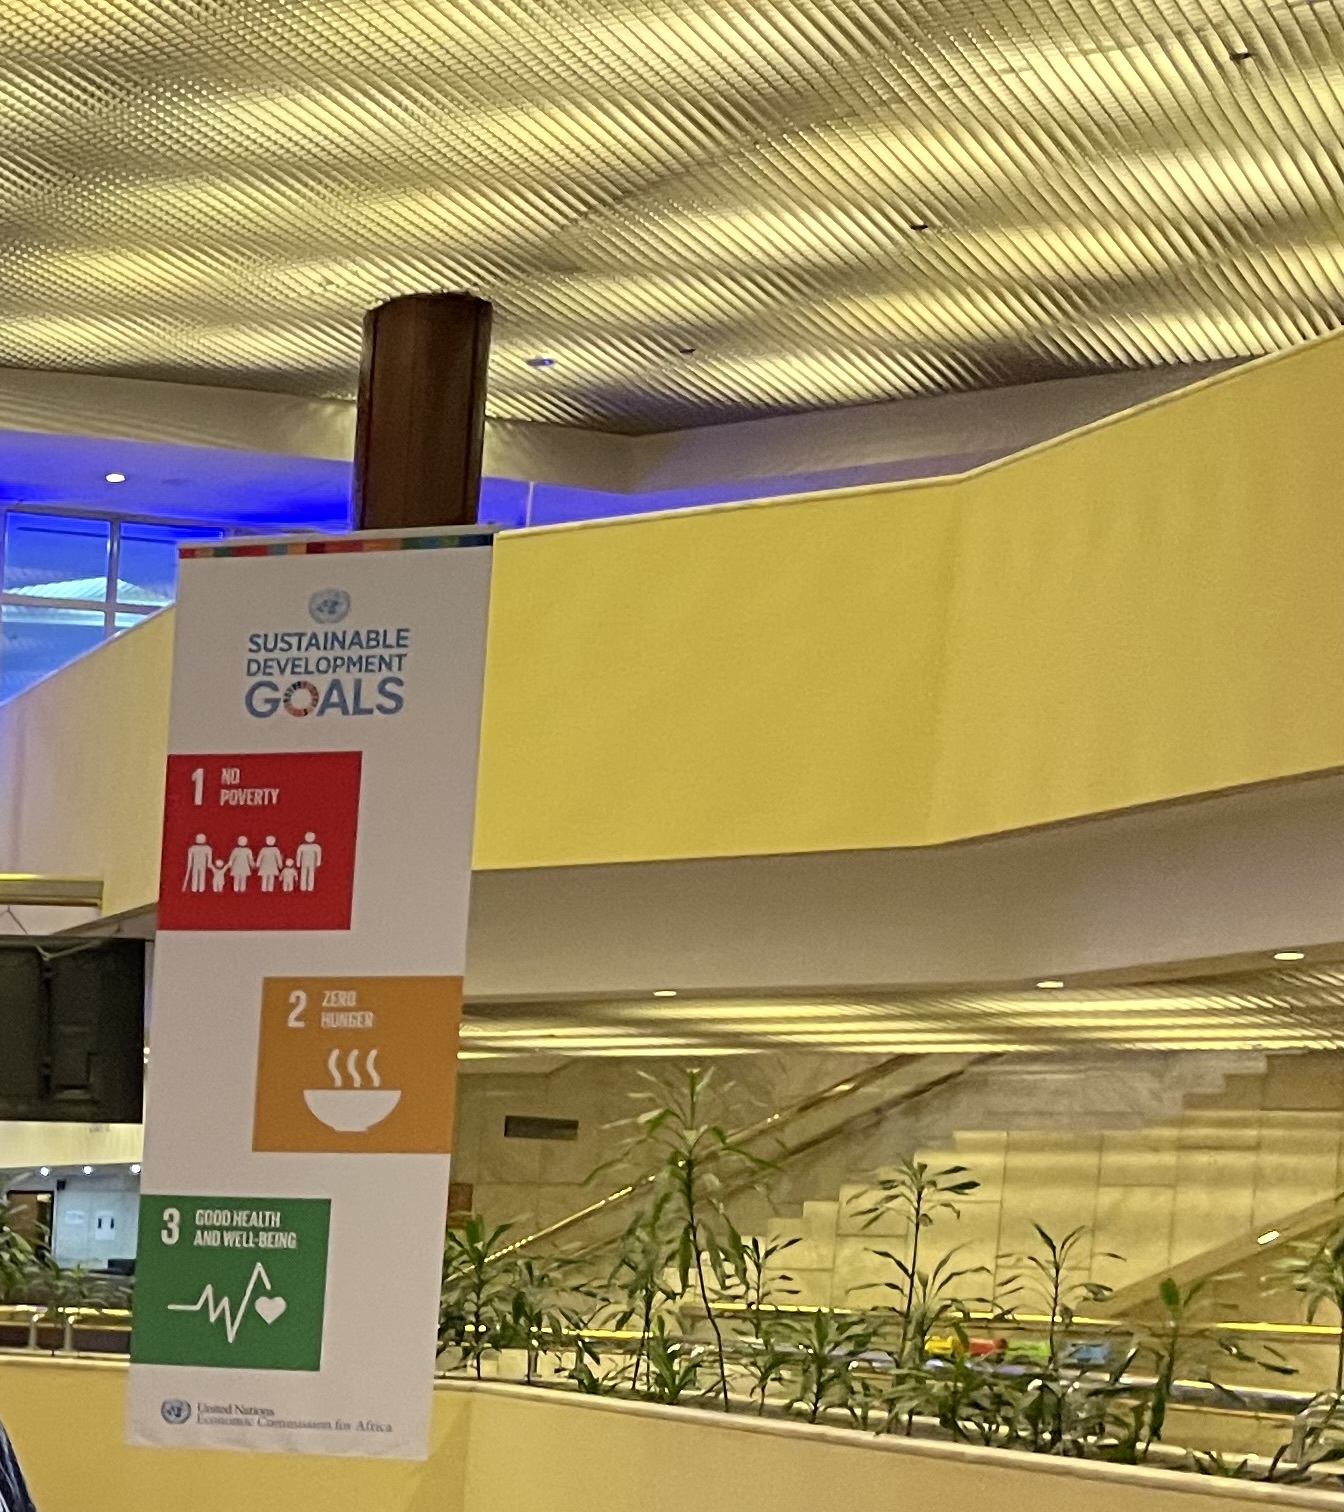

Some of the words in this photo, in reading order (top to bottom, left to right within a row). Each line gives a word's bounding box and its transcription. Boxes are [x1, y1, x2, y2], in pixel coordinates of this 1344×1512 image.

[248, 628, 410, 653] SUSTAINABLE
[246, 653, 408, 677] DEVELOPMENT
[244, 676, 405, 718] GOALS
[221, 768, 240, 784] NO
[191, 768, 204, 806] 1
[220, 788, 280, 806] POVERTY
[322, 990, 357, 1007] ZERO
[287, 990, 308, 1028] 2
[321, 1011, 374, 1029] HUNGER
[161, 1207, 181, 1245] 3
[195, 1209, 230, 1226] GOOD
[233, 1210, 281, 1228] HEALTH
[193, 1230, 221, 1247] AND
[223, 1231, 297, 1249] WELL-BEING
[197, 1402, 232, 1414] United
[234, 1404, 275, 1416] Nations
[356, 1420, 392, 1433] Africa
